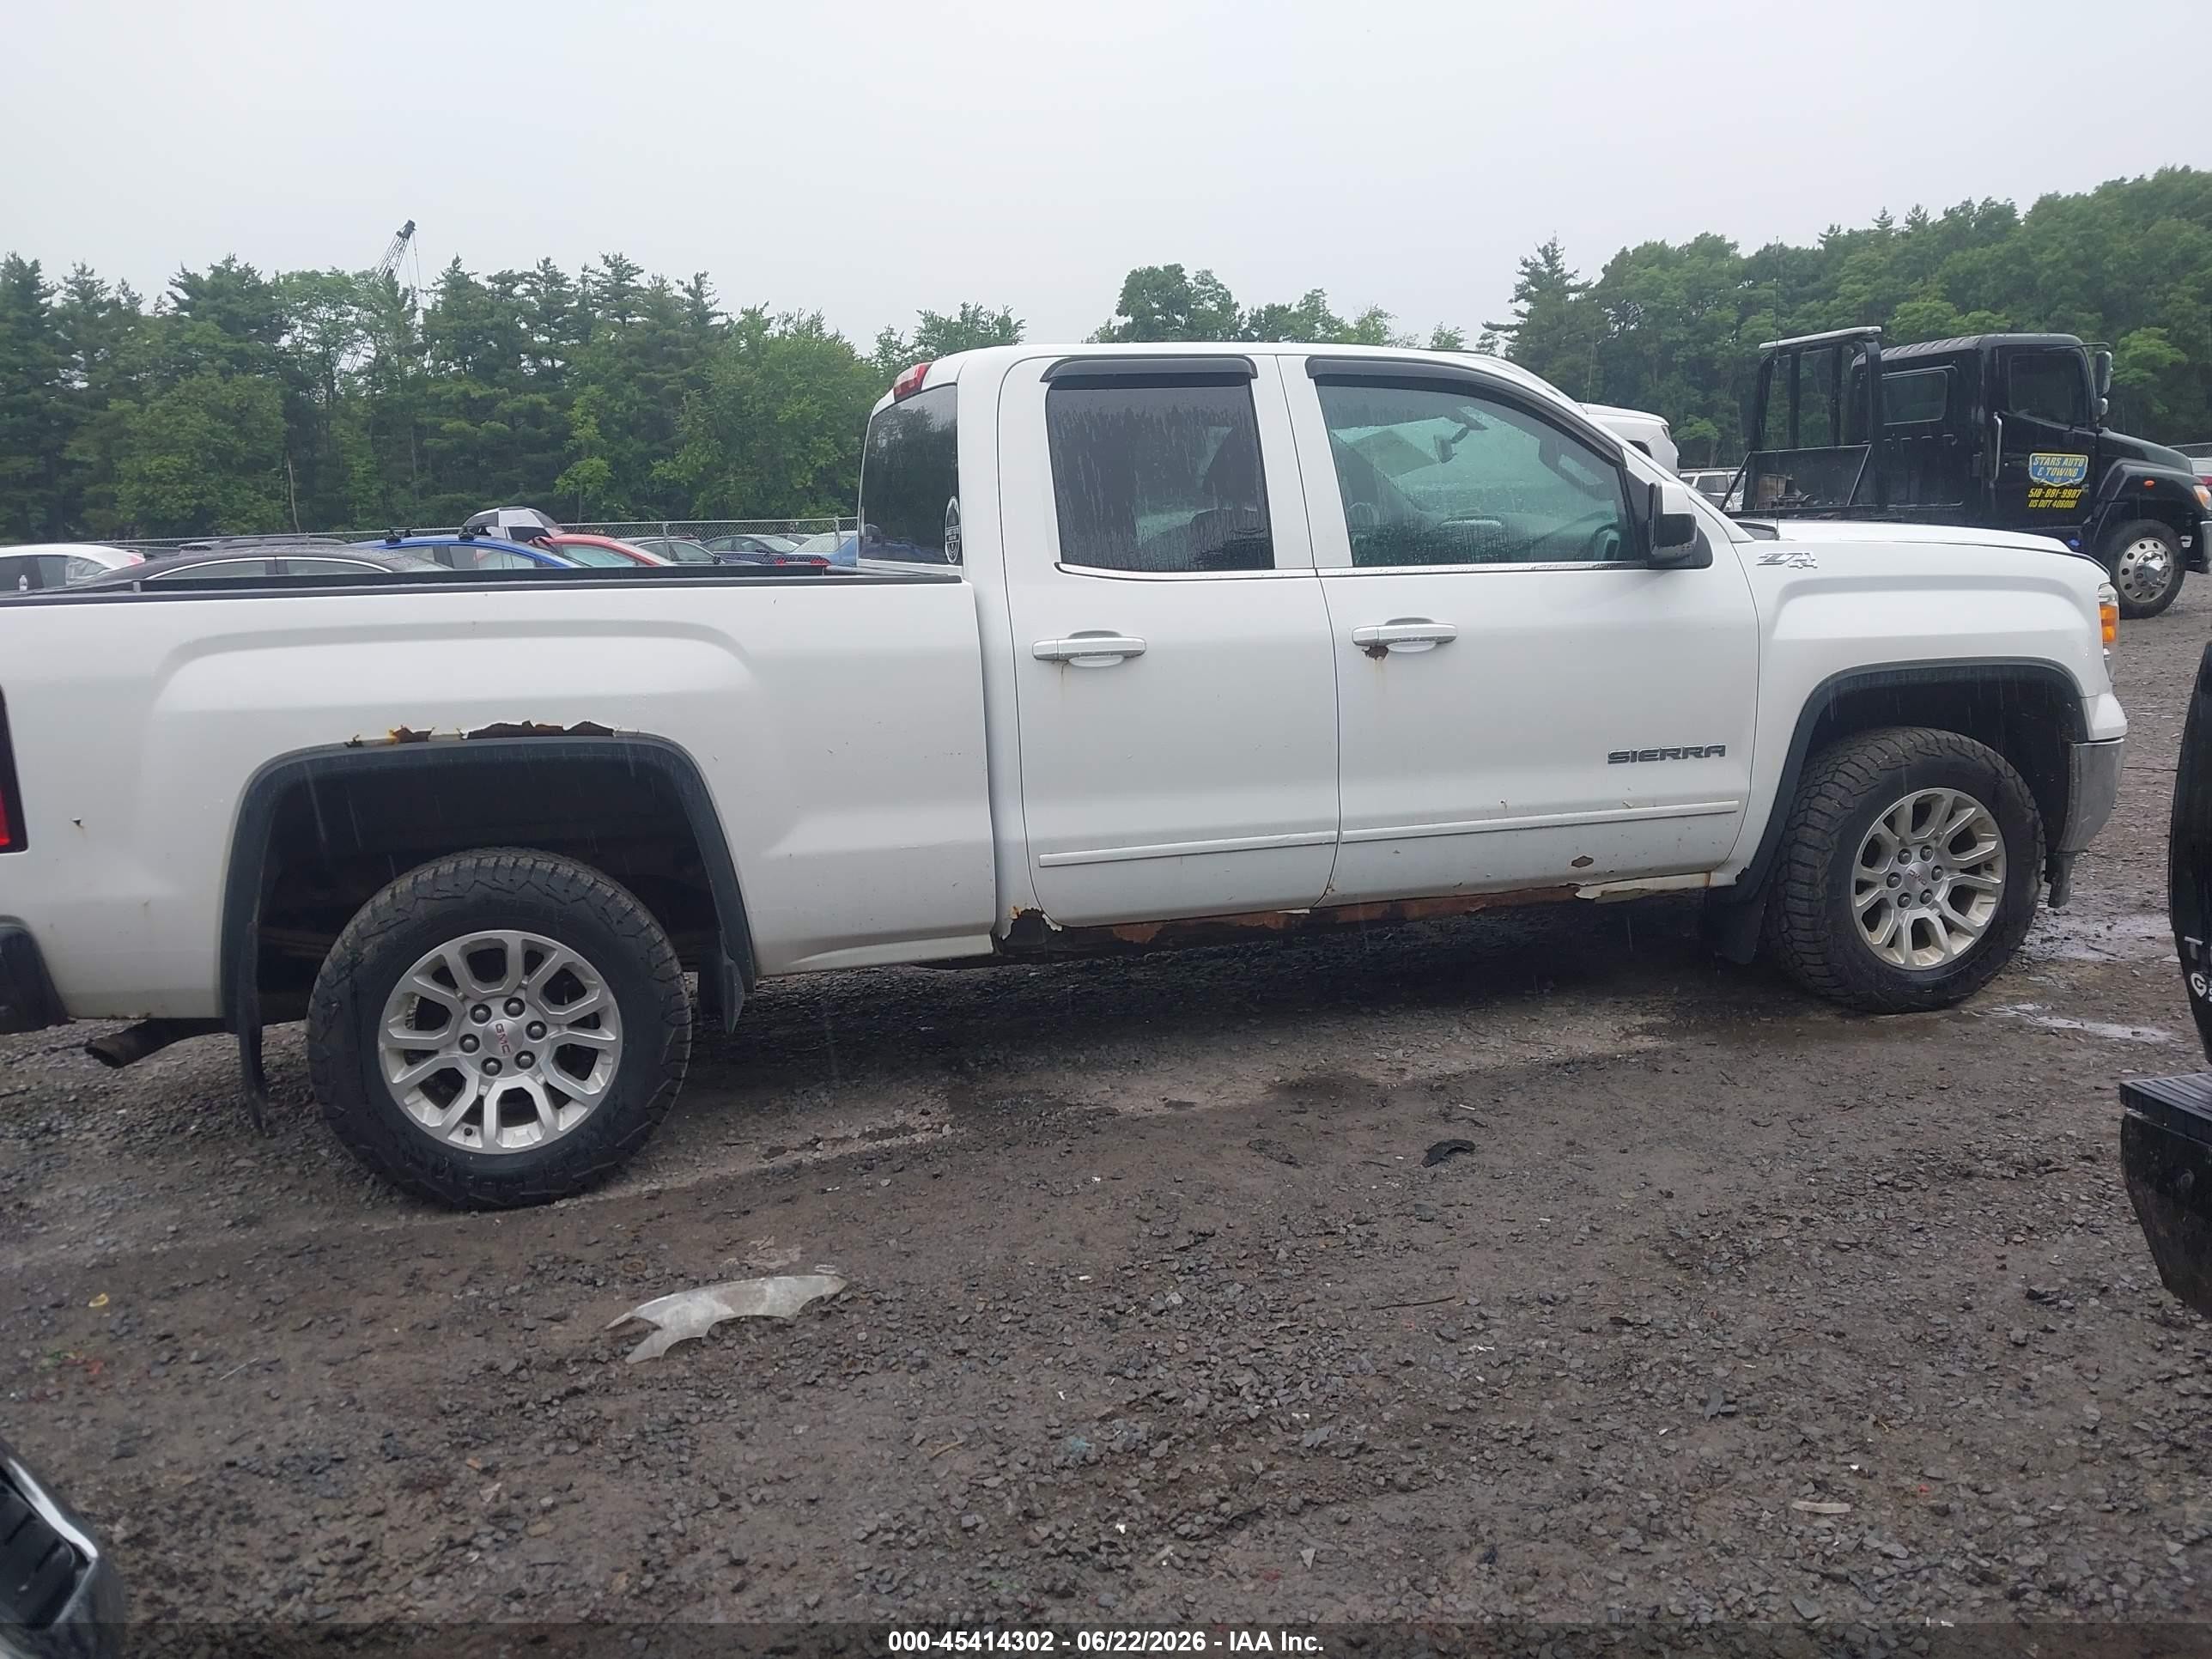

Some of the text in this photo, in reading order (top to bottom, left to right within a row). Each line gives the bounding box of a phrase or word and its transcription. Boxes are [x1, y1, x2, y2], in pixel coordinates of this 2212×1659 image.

[2033, 457, 2085, 466] STARS AUTO
[2045, 467, 2079, 477] TOWING
[1607, 744, 1726, 764] SIERRA
[495, 1022, 512, 1054] GMC
